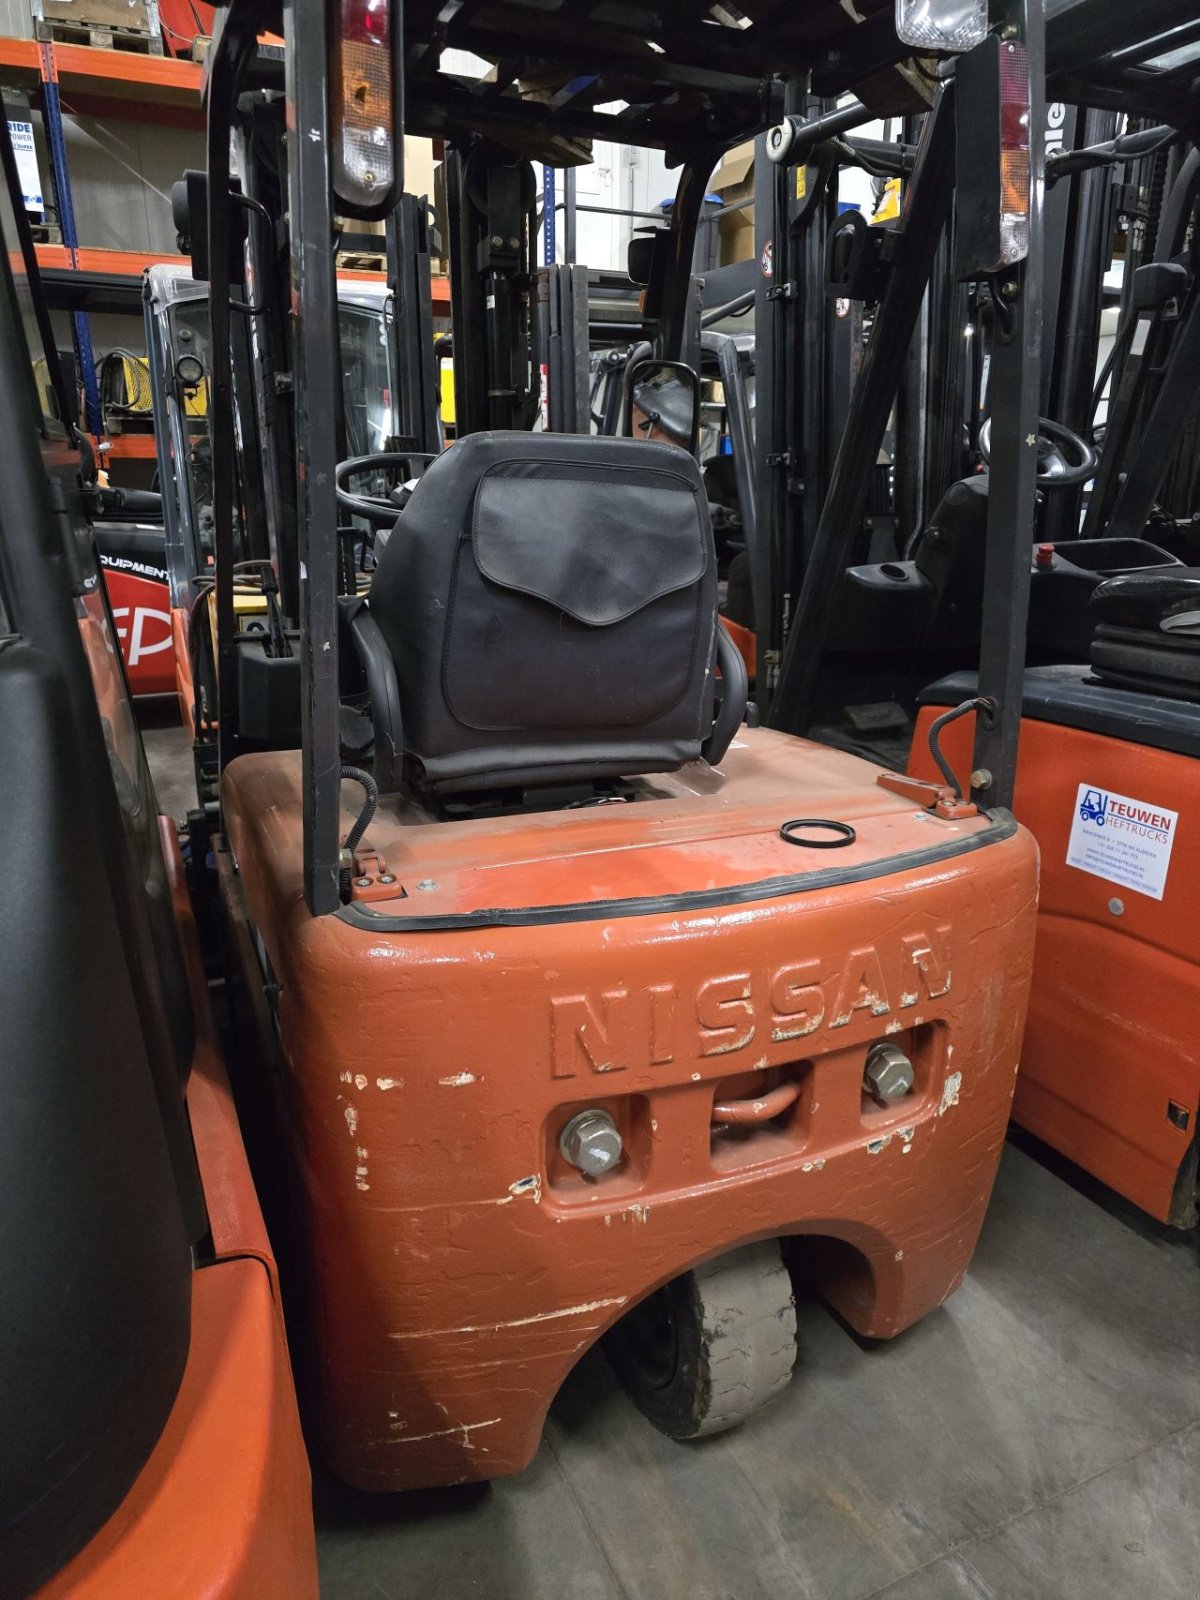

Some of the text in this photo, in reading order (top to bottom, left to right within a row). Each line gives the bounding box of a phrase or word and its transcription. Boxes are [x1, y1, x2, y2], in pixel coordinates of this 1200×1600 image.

[1105, 816, 1168, 844] HEFTRUCKS
[1109, 800, 1171, 830] TEUWEN
[551, 924, 953, 1080] NISSAN
